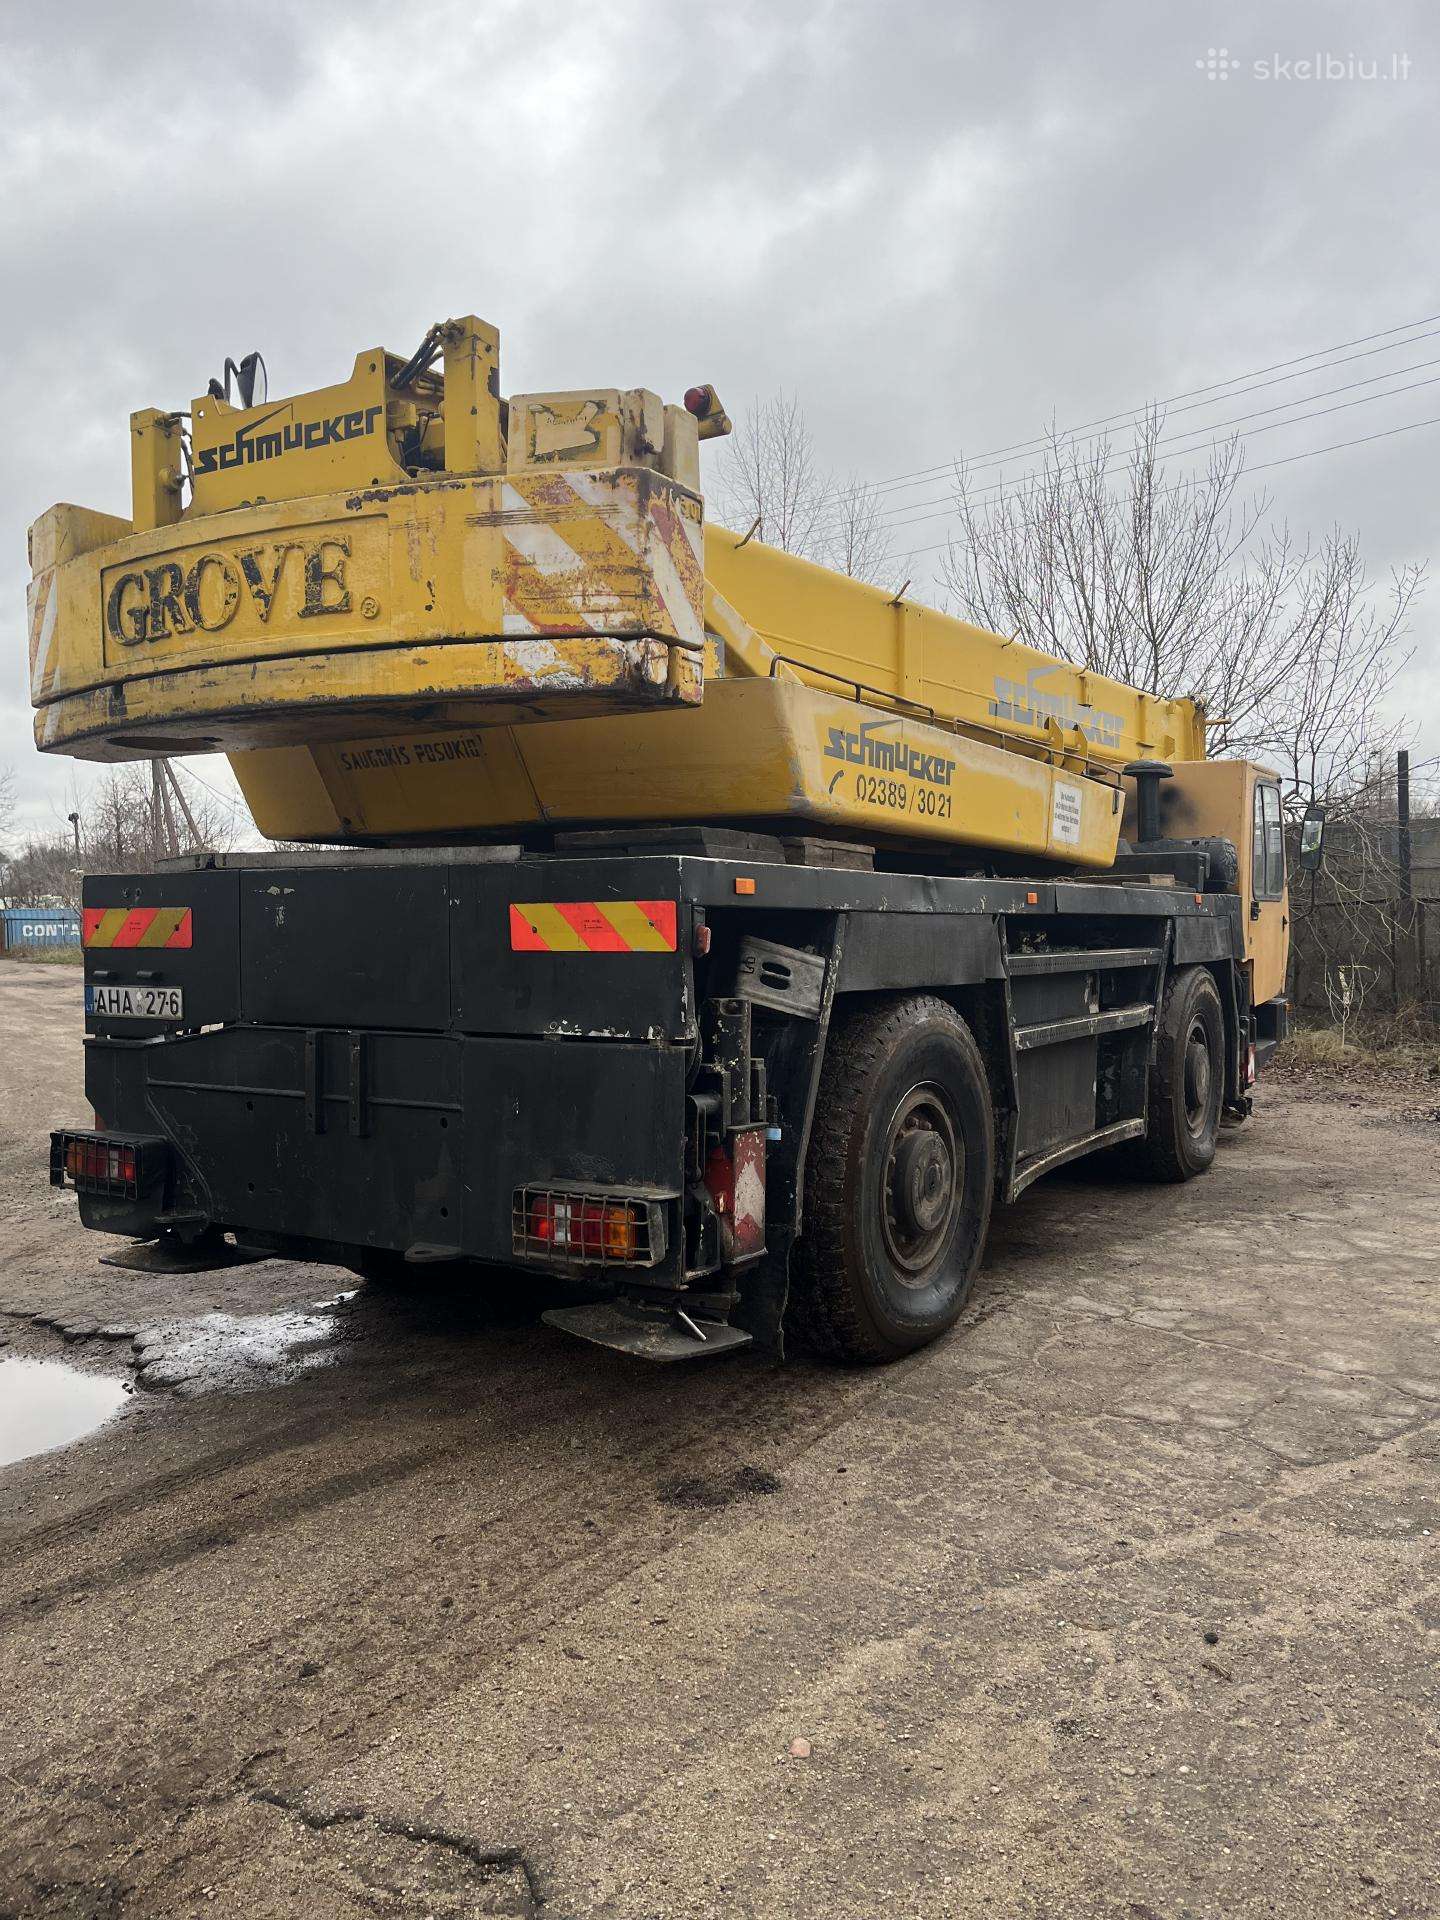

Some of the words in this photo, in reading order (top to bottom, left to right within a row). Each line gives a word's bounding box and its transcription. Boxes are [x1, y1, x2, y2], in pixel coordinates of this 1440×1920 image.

[107, 535, 352, 646] GROVE
[96, 989, 134, 1014] AHA
[144, 990, 180, 1015] 276
